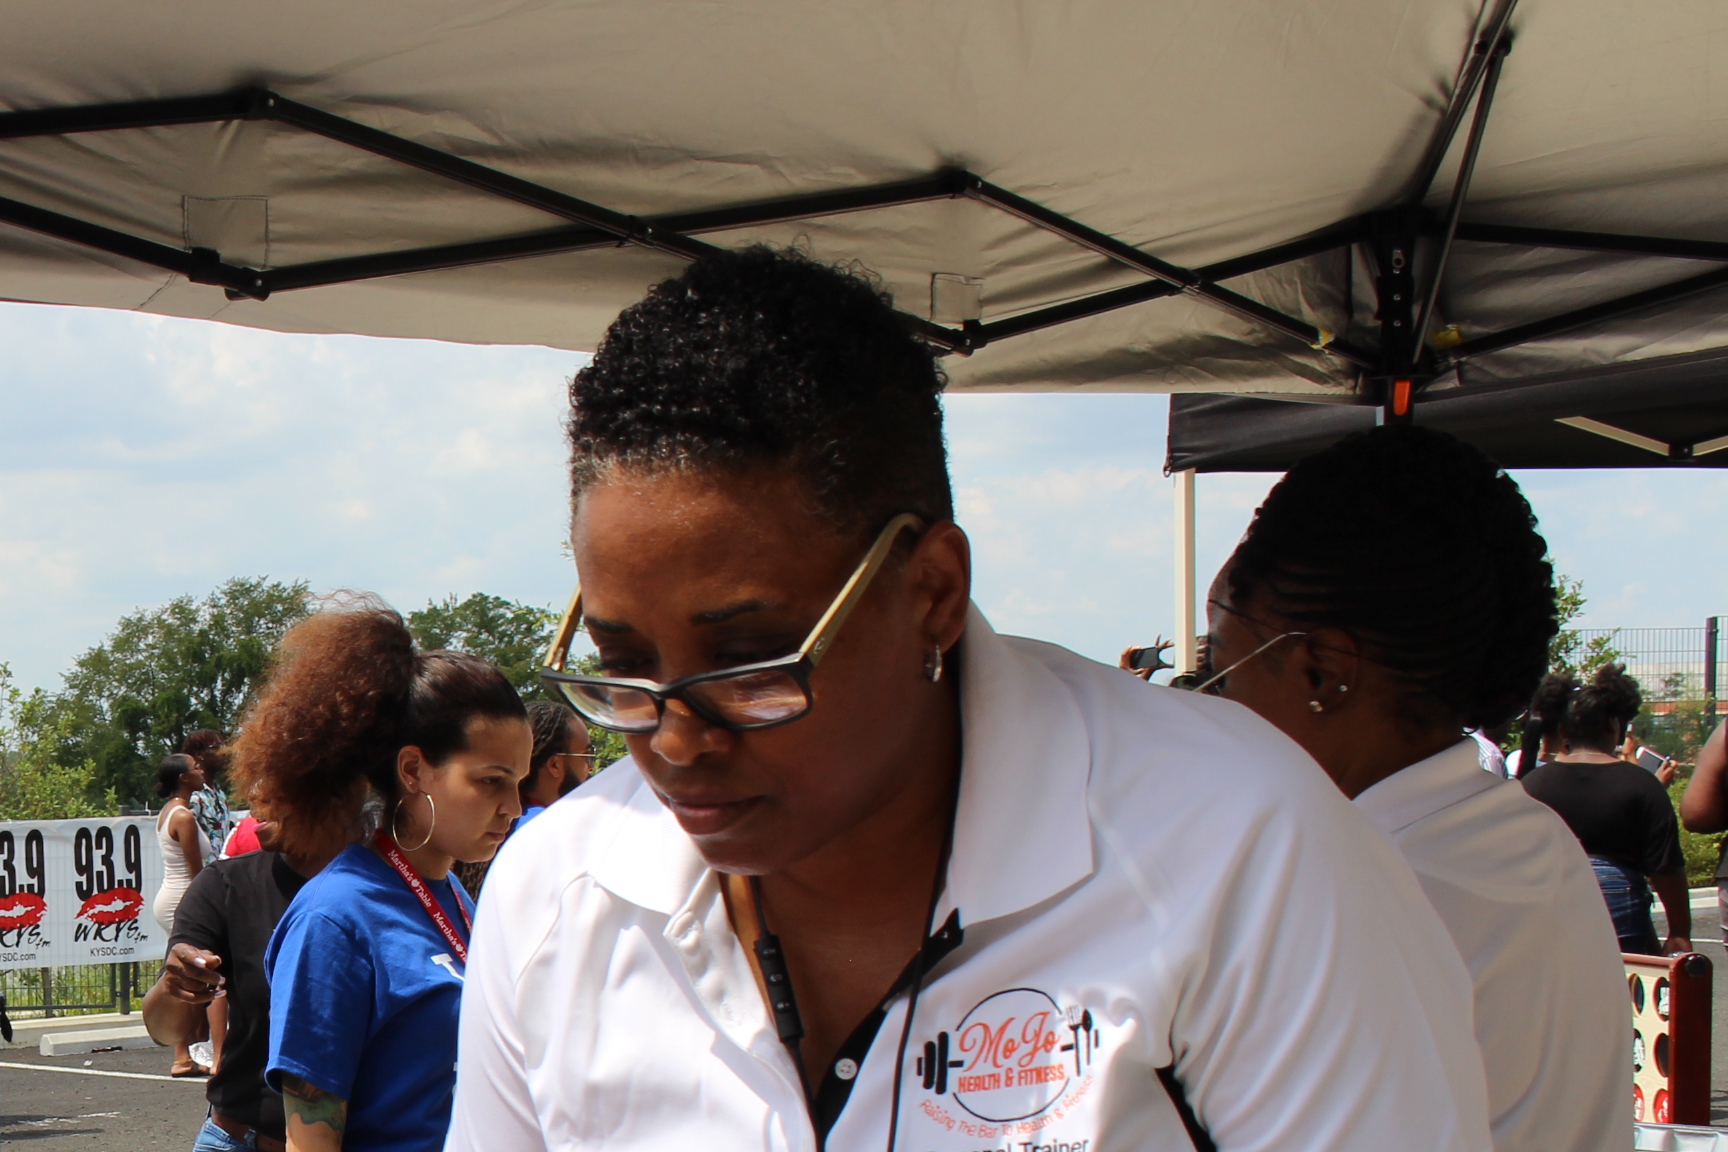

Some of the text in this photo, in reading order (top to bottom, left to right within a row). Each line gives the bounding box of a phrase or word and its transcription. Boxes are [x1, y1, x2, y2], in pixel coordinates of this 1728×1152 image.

[74, 824, 142, 902] 93.9
[387, 849, 414, 882] Martha's
[415, 885, 432, 908] Table
[73, 918, 139, 943] WKYS
[432, 911, 457, 946] Martha's
[89, 945, 135, 957] KYSDC.com
[958, 1063, 1066, 1094] HEALTH & FITNESS
[919, 1098, 957, 1132] Raising
[957, 1120, 977, 1137] The
[978, 1124, 999, 1139] Bar
